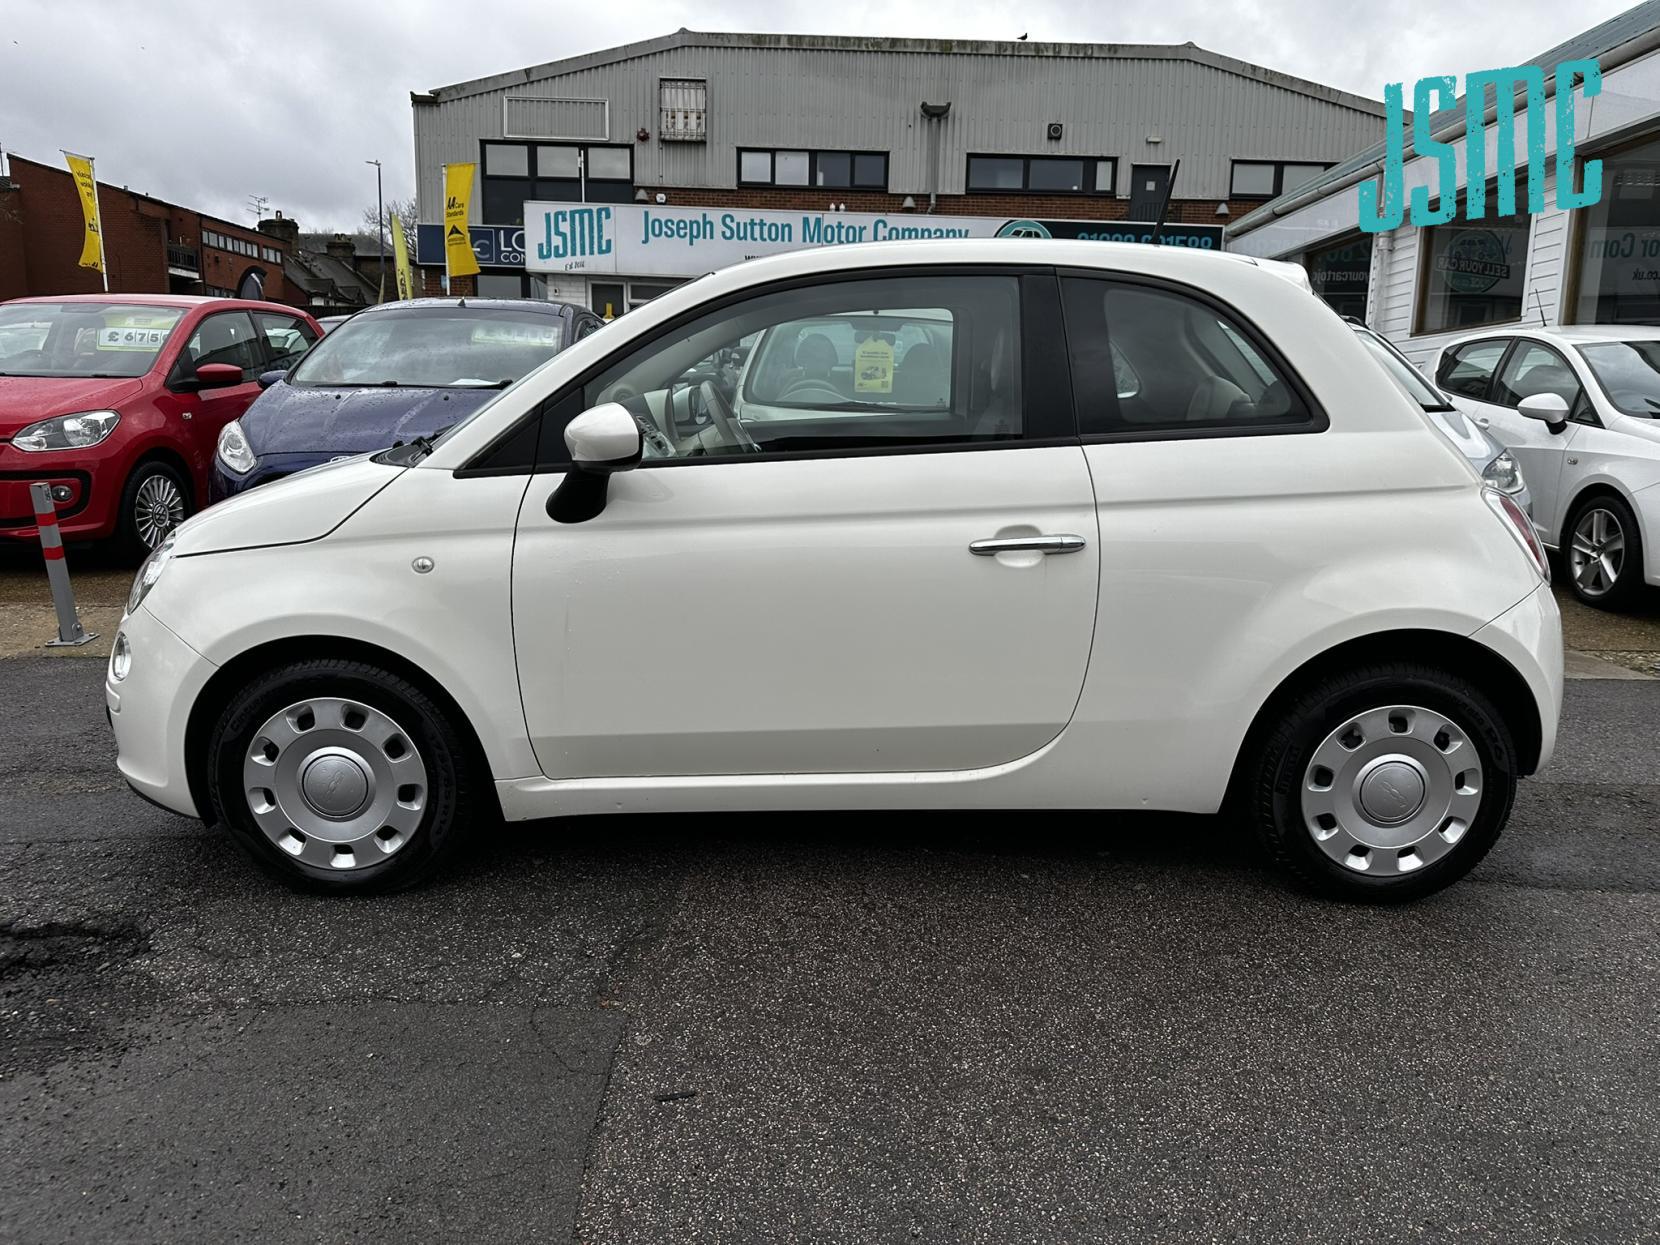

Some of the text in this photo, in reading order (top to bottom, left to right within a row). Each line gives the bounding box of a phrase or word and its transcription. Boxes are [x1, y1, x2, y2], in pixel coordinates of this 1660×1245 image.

[537, 207, 612, 259] JSMC
[642, 211, 714, 246] Joseph
[721, 213, 792, 242] Sutton
[802, 216, 866, 244] Motor
